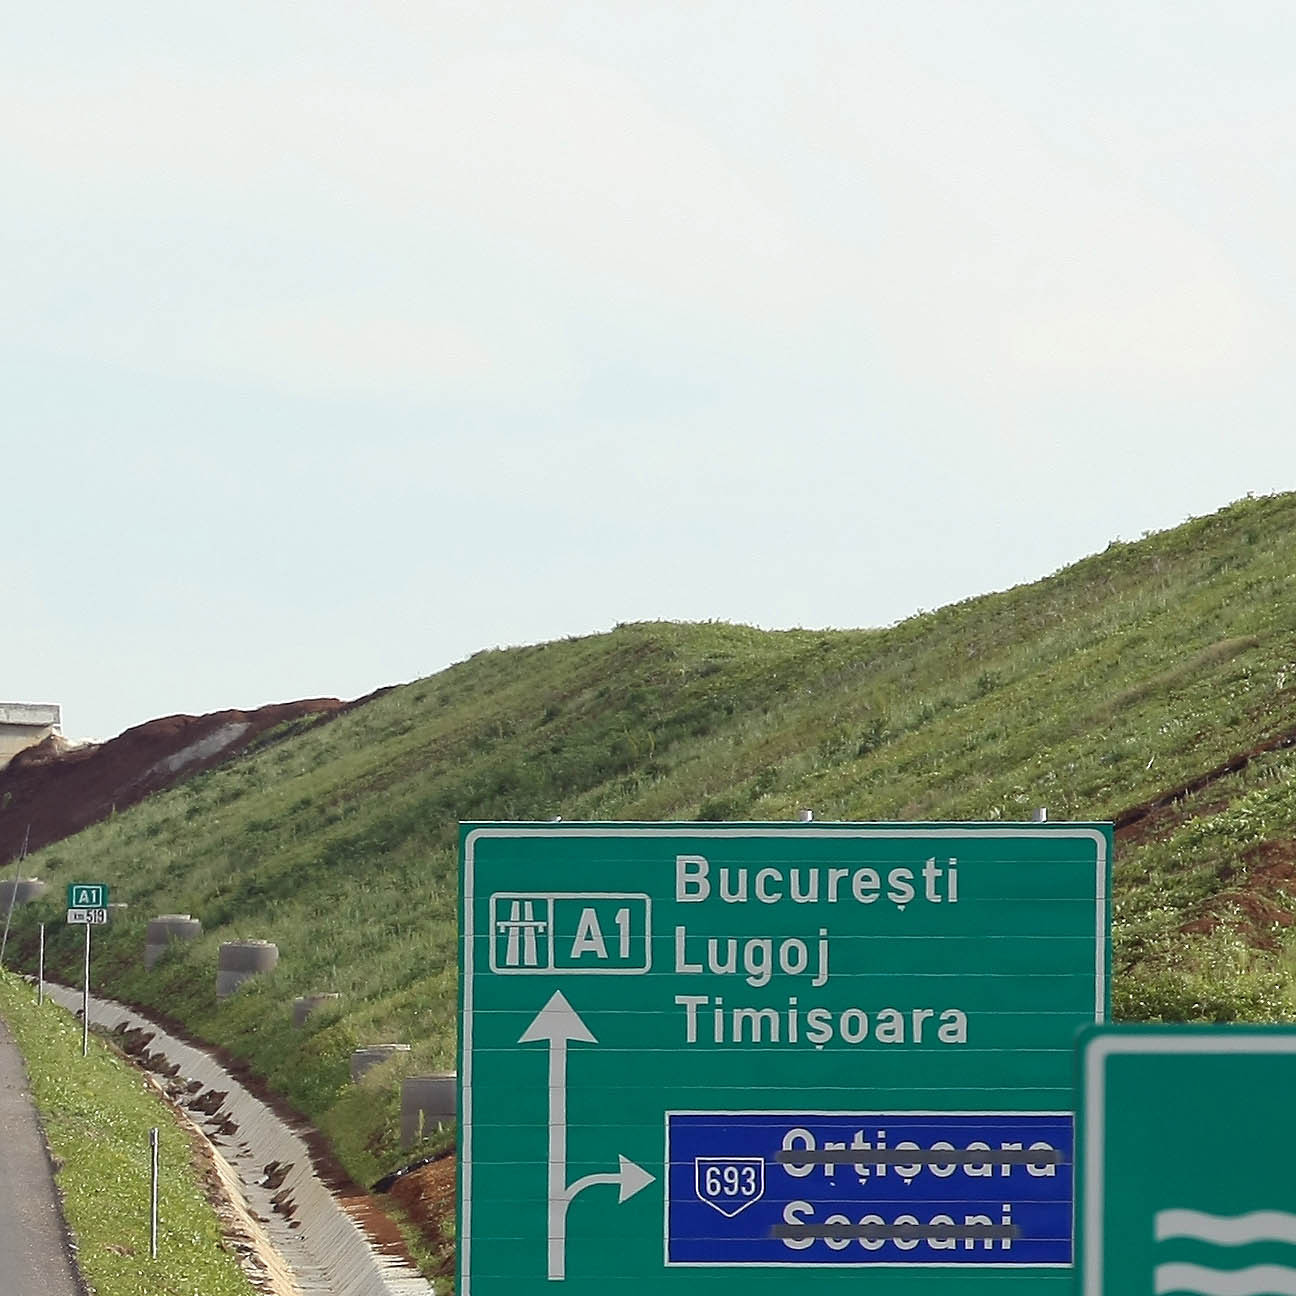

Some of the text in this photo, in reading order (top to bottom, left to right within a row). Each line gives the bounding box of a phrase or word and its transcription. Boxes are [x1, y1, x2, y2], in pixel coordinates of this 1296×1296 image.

[78, 890, 96, 903] A1
[675, 855, 959, 912] București
[86, 909, 104, 923] 519
[570, 907, 630, 959] A1
[674, 925, 829, 987] Lugoj
[674, 995, 968, 1051] Timișoara
[706, 1166, 757, 1196] 693
